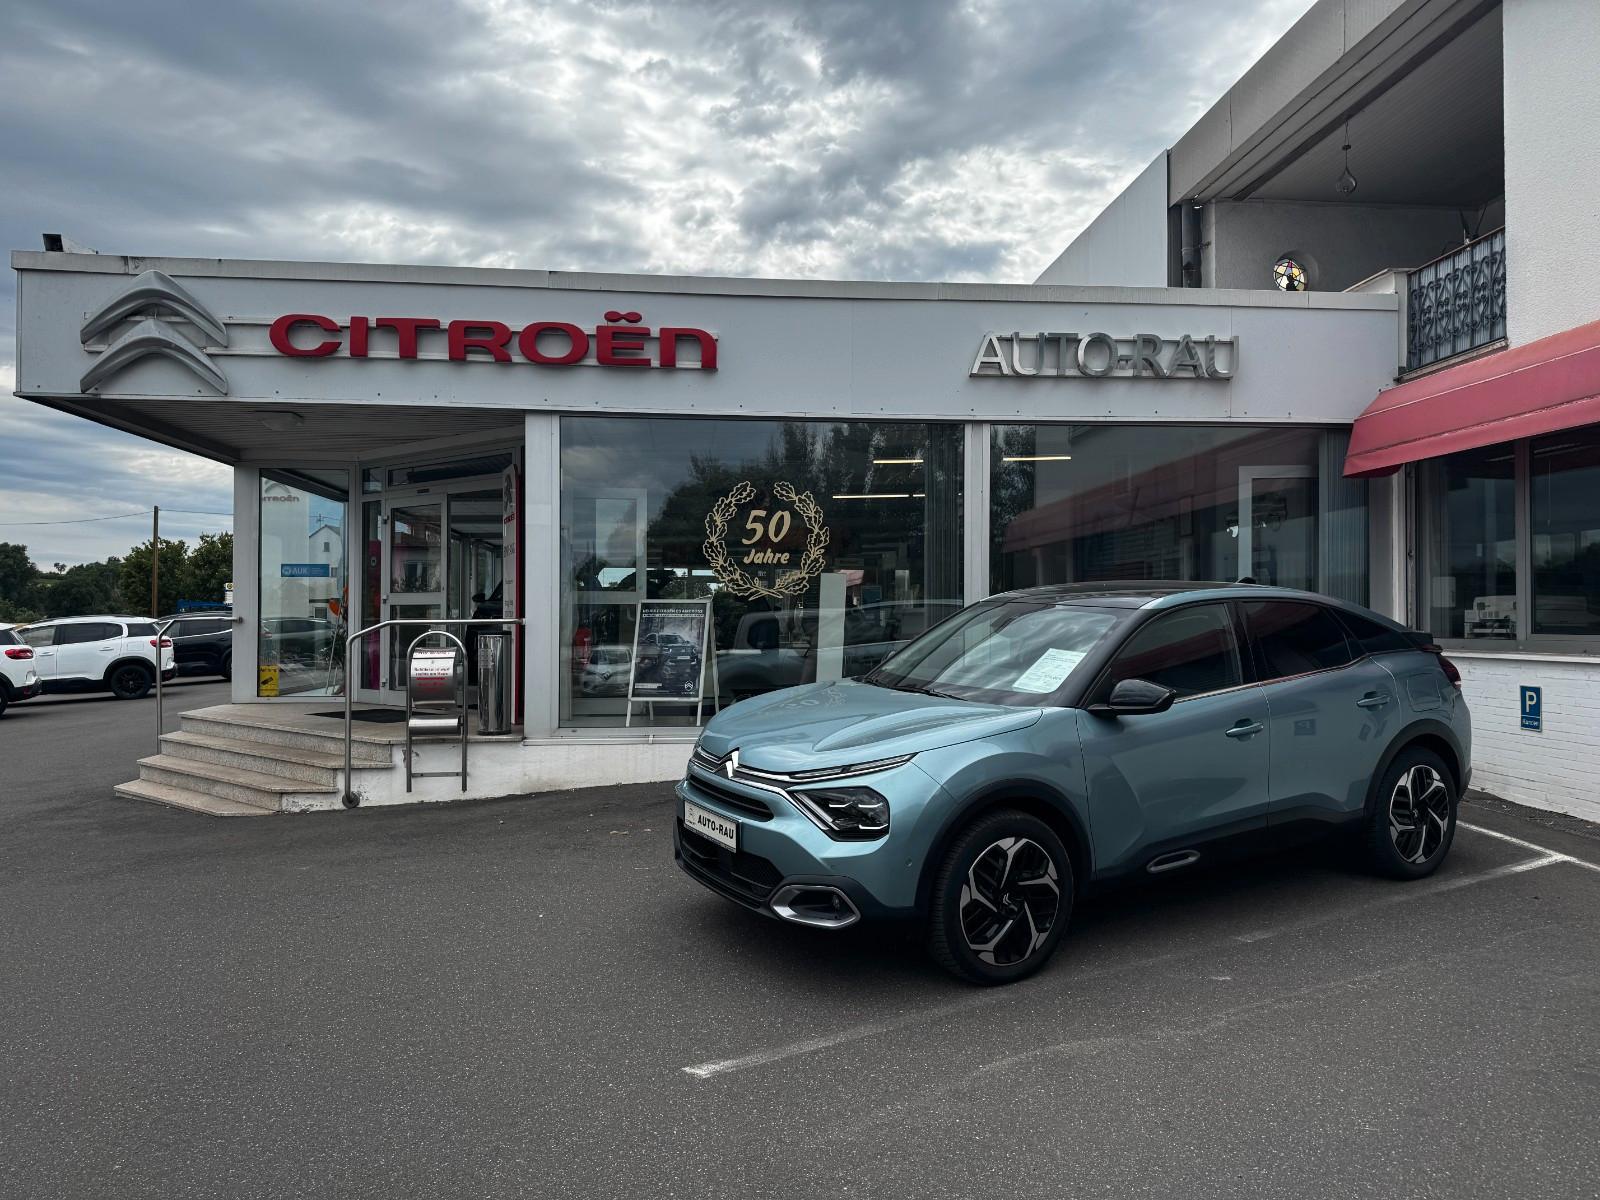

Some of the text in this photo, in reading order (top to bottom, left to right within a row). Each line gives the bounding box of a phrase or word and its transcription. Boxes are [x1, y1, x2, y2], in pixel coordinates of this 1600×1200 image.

[969, 331, 1240, 381] AUTO-RAU
[742, 509, 791, 545] 50
[743, 548, 790, 564] Jahre
[1525, 691, 1537, 713] P
[698, 815, 734, 839] AUTO-RAU
